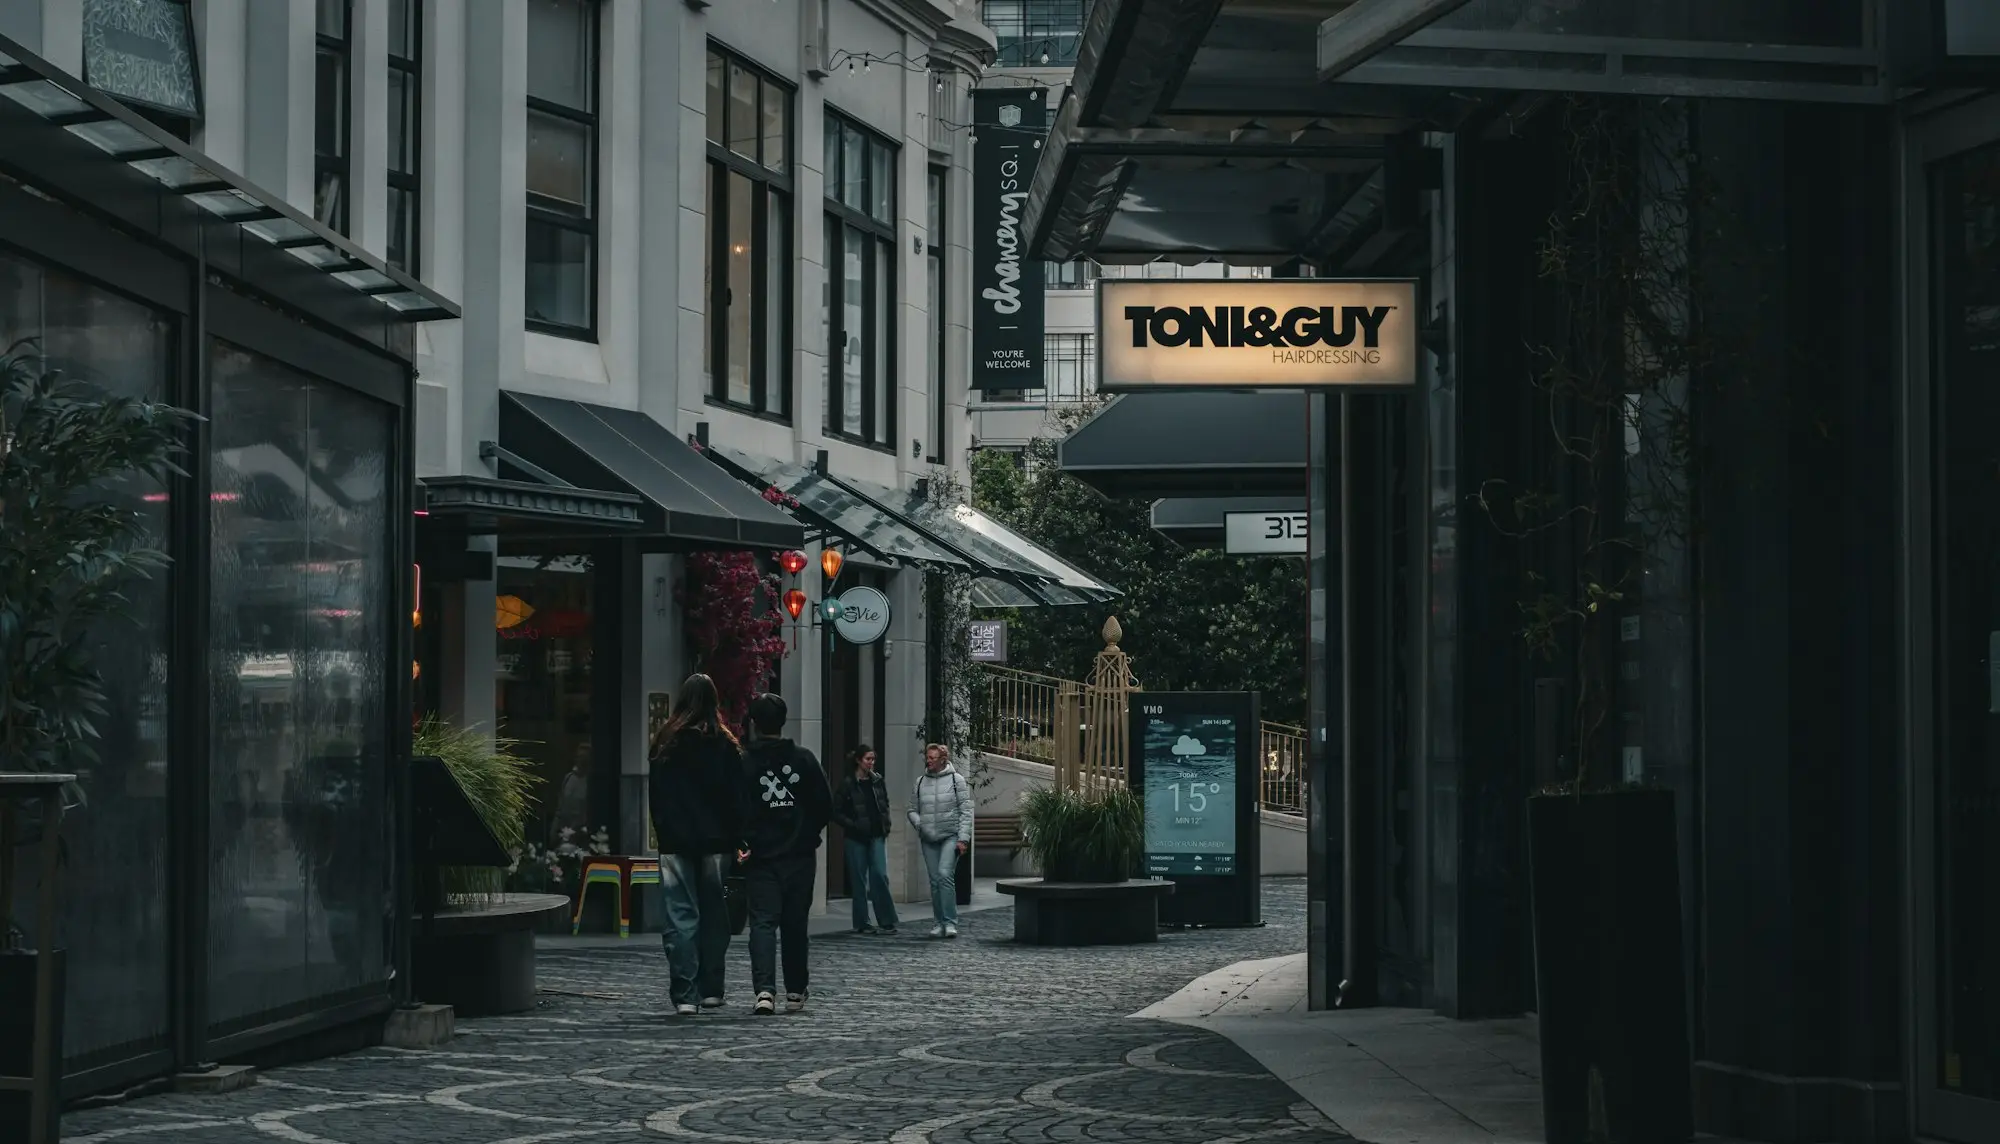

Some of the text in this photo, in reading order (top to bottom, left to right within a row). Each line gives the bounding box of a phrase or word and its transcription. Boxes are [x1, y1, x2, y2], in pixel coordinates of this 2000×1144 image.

[982, 153, 1028, 314] chancery SQ.
[1125, 306, 1389, 347] TONI&GUY
[992, 350, 1024, 358] YOU'RE
[1273, 350, 1381, 364] HAIRDRESSING
[985, 360, 1031, 368] WELCOME
[1265, 517, 1307, 538] 313
[857, 606, 881, 620] Vie
[1143, 705, 1163, 714] VMO
